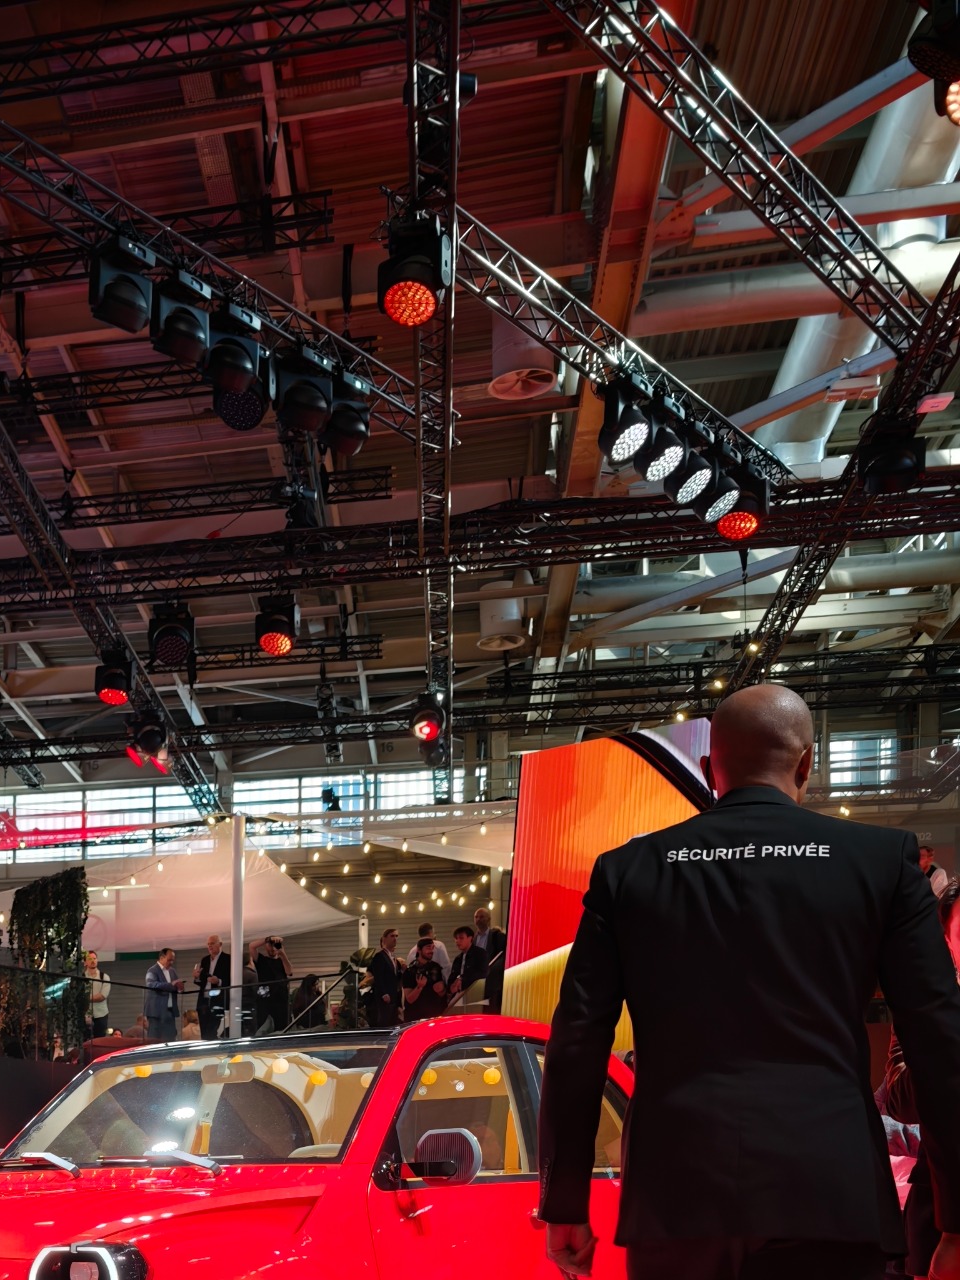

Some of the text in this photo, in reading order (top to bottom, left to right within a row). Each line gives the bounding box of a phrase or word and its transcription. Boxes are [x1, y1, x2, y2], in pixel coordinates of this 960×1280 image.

[381, 741, 394, 752] 16
[666, 842, 831, 863] SÉCURITÉ PRIVÉE
